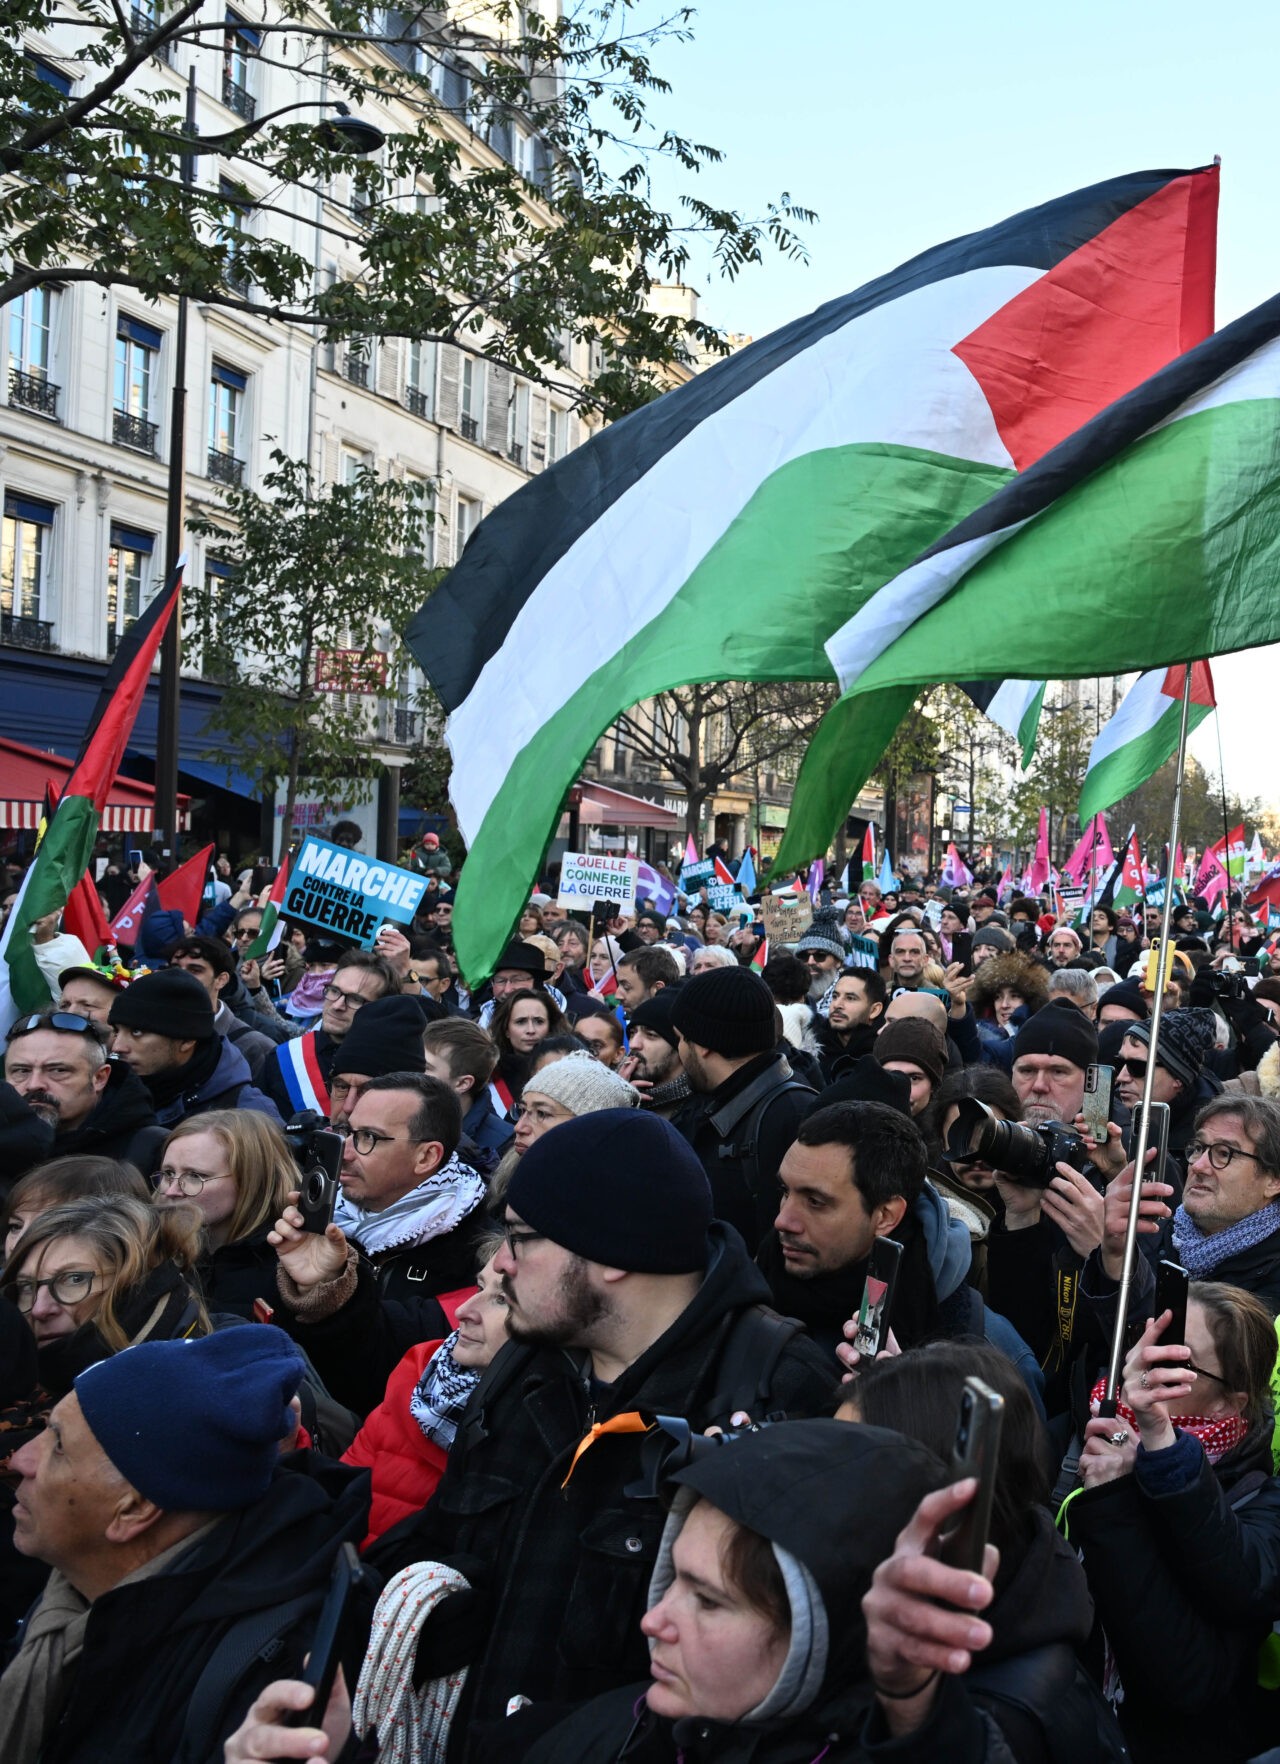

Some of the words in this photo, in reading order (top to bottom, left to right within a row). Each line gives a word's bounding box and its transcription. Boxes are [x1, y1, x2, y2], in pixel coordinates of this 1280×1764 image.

[298, 842, 424, 910] MARCHE
[566, 868, 631, 887] CONNERIE
[681, 861, 714, 878] MARCHE
[303, 876, 351, 902] CONTRE
[350, 893, 365, 909] LA
[560, 882, 576, 894] LA
[707, 885, 734, 900] CESSEZ
[287, 887, 378, 940] GUERRE
[1062, 1276, 1071, 1304] Nikon
